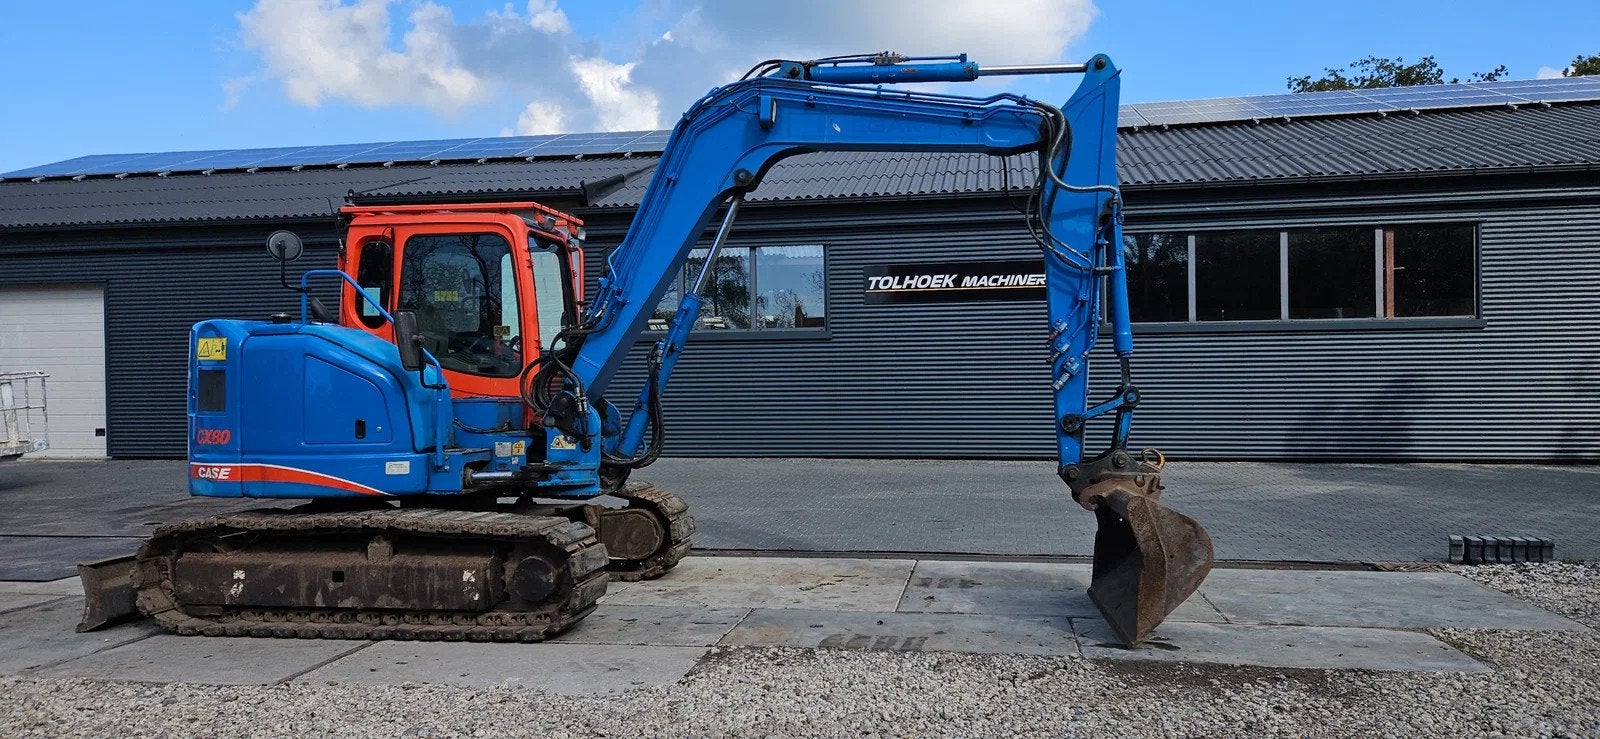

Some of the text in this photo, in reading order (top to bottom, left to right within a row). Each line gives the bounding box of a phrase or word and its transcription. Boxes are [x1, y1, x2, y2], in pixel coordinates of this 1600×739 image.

[868, 274, 957, 290] TOLHOEK
[197, 429, 231, 444] CX80
[198, 467, 231, 480] CASE
